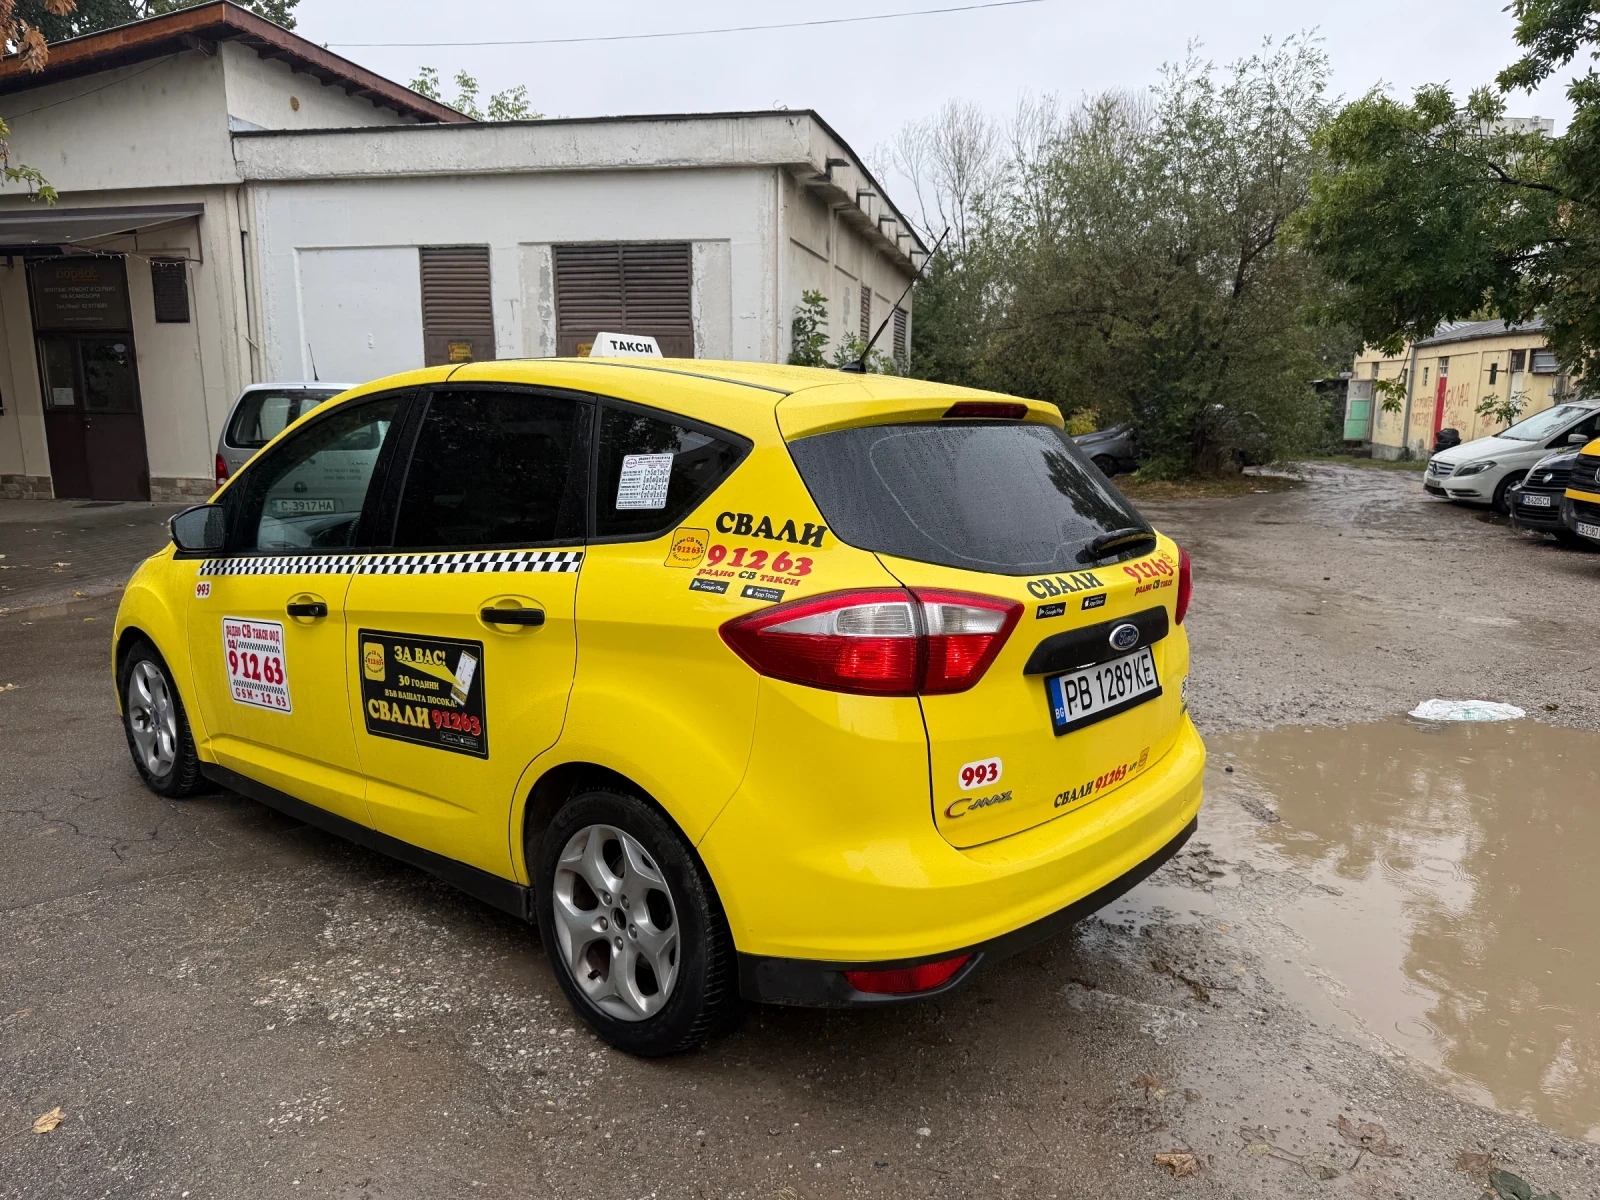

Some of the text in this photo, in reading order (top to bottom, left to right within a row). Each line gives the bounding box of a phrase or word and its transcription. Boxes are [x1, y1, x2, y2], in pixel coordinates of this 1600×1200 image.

[610, 340, 653, 353] ТАКСИ
[715, 512, 828, 547] СВАЛИ
[739, 571, 757, 580] СВ
[760, 574, 801, 587] такси
[1123, 559, 1174, 584] 91263
[196, 584, 210, 596] 993
[1027, 572, 1104, 600] СВАЛИ
[1118, 630, 1137, 646] Ford
[394, 645, 446, 666] ЗА ВАС!
[398, 675, 410, 686] 30
[1096, 662, 1133, 704] 1289
[235, 687, 254, 700] GSM
[398, 691, 426, 703] ВАШАТА
[368, 698, 481, 736] СВАЛИ 91263
[1055, 707, 1065, 719] BG
[961, 763, 998, 787] 993
[1054, 780, 1095, 808] СВАЛИ
[1095, 764, 1128, 794] 91263
